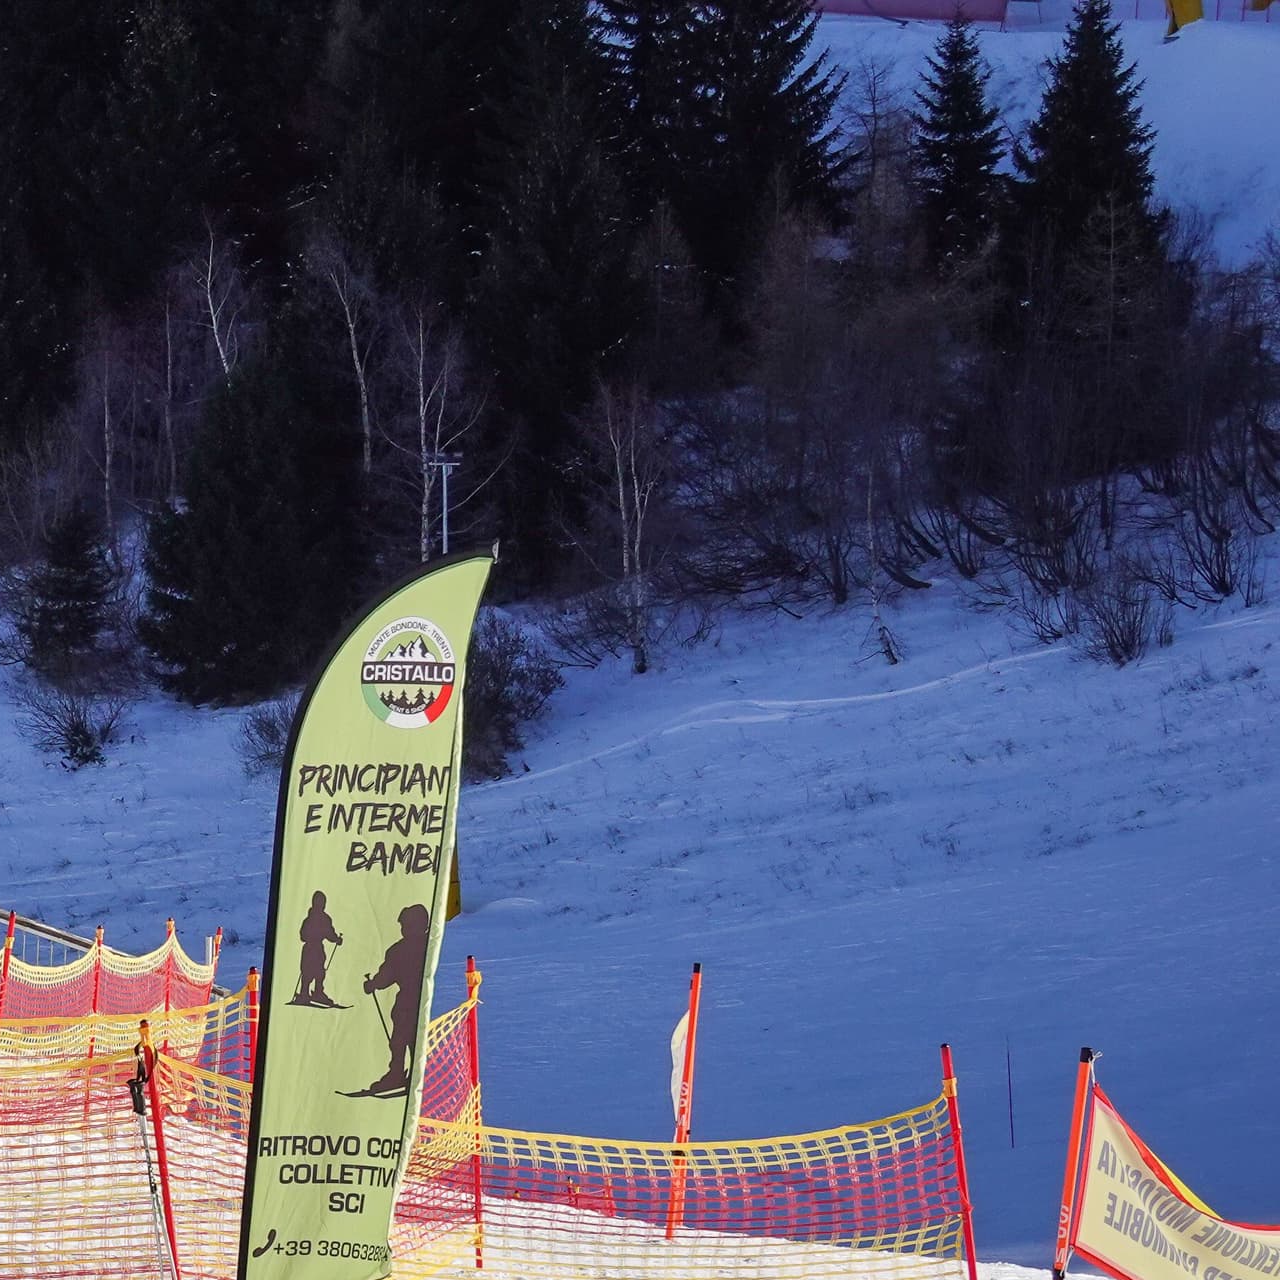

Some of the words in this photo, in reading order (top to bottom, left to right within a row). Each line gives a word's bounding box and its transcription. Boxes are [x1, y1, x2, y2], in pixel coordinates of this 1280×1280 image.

[368, 631, 392, 657] MONTE
[390, 621, 428, 635] BONDONE
[431, 629, 452, 660] TRENTO
[362, 664, 454, 683] CRISTALLO
[304, 804, 323, 834] E
[345, 841, 440, 876] BAMBI
[259, 1135, 361, 1157] RITROVO
[328, 1192, 365, 1214] SCI
[274, 1240, 312, 1256] +39
